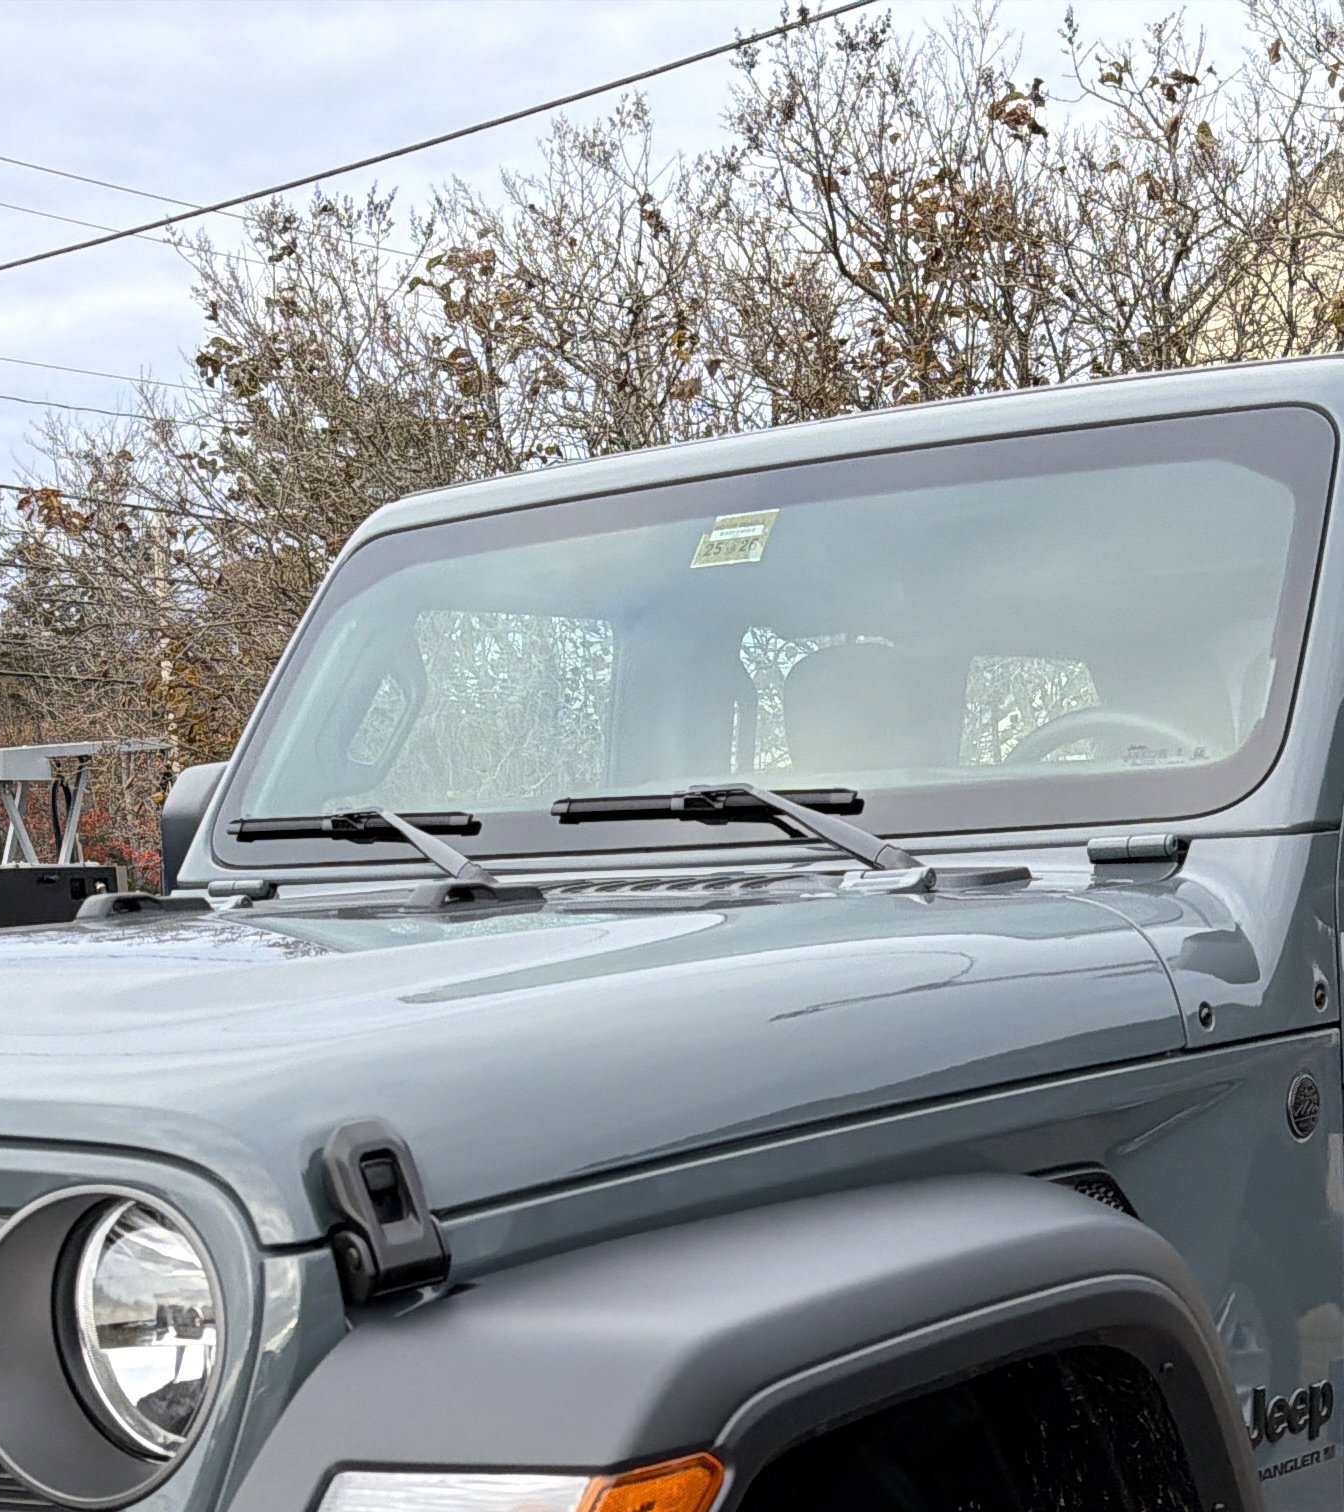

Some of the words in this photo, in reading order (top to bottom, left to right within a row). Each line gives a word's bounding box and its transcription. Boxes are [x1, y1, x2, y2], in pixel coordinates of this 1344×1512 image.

[703, 541, 723, 557] 25
[1246, 1380, 1334, 1450] Jeep
[1258, 1450, 1321, 1481] ANGLER
